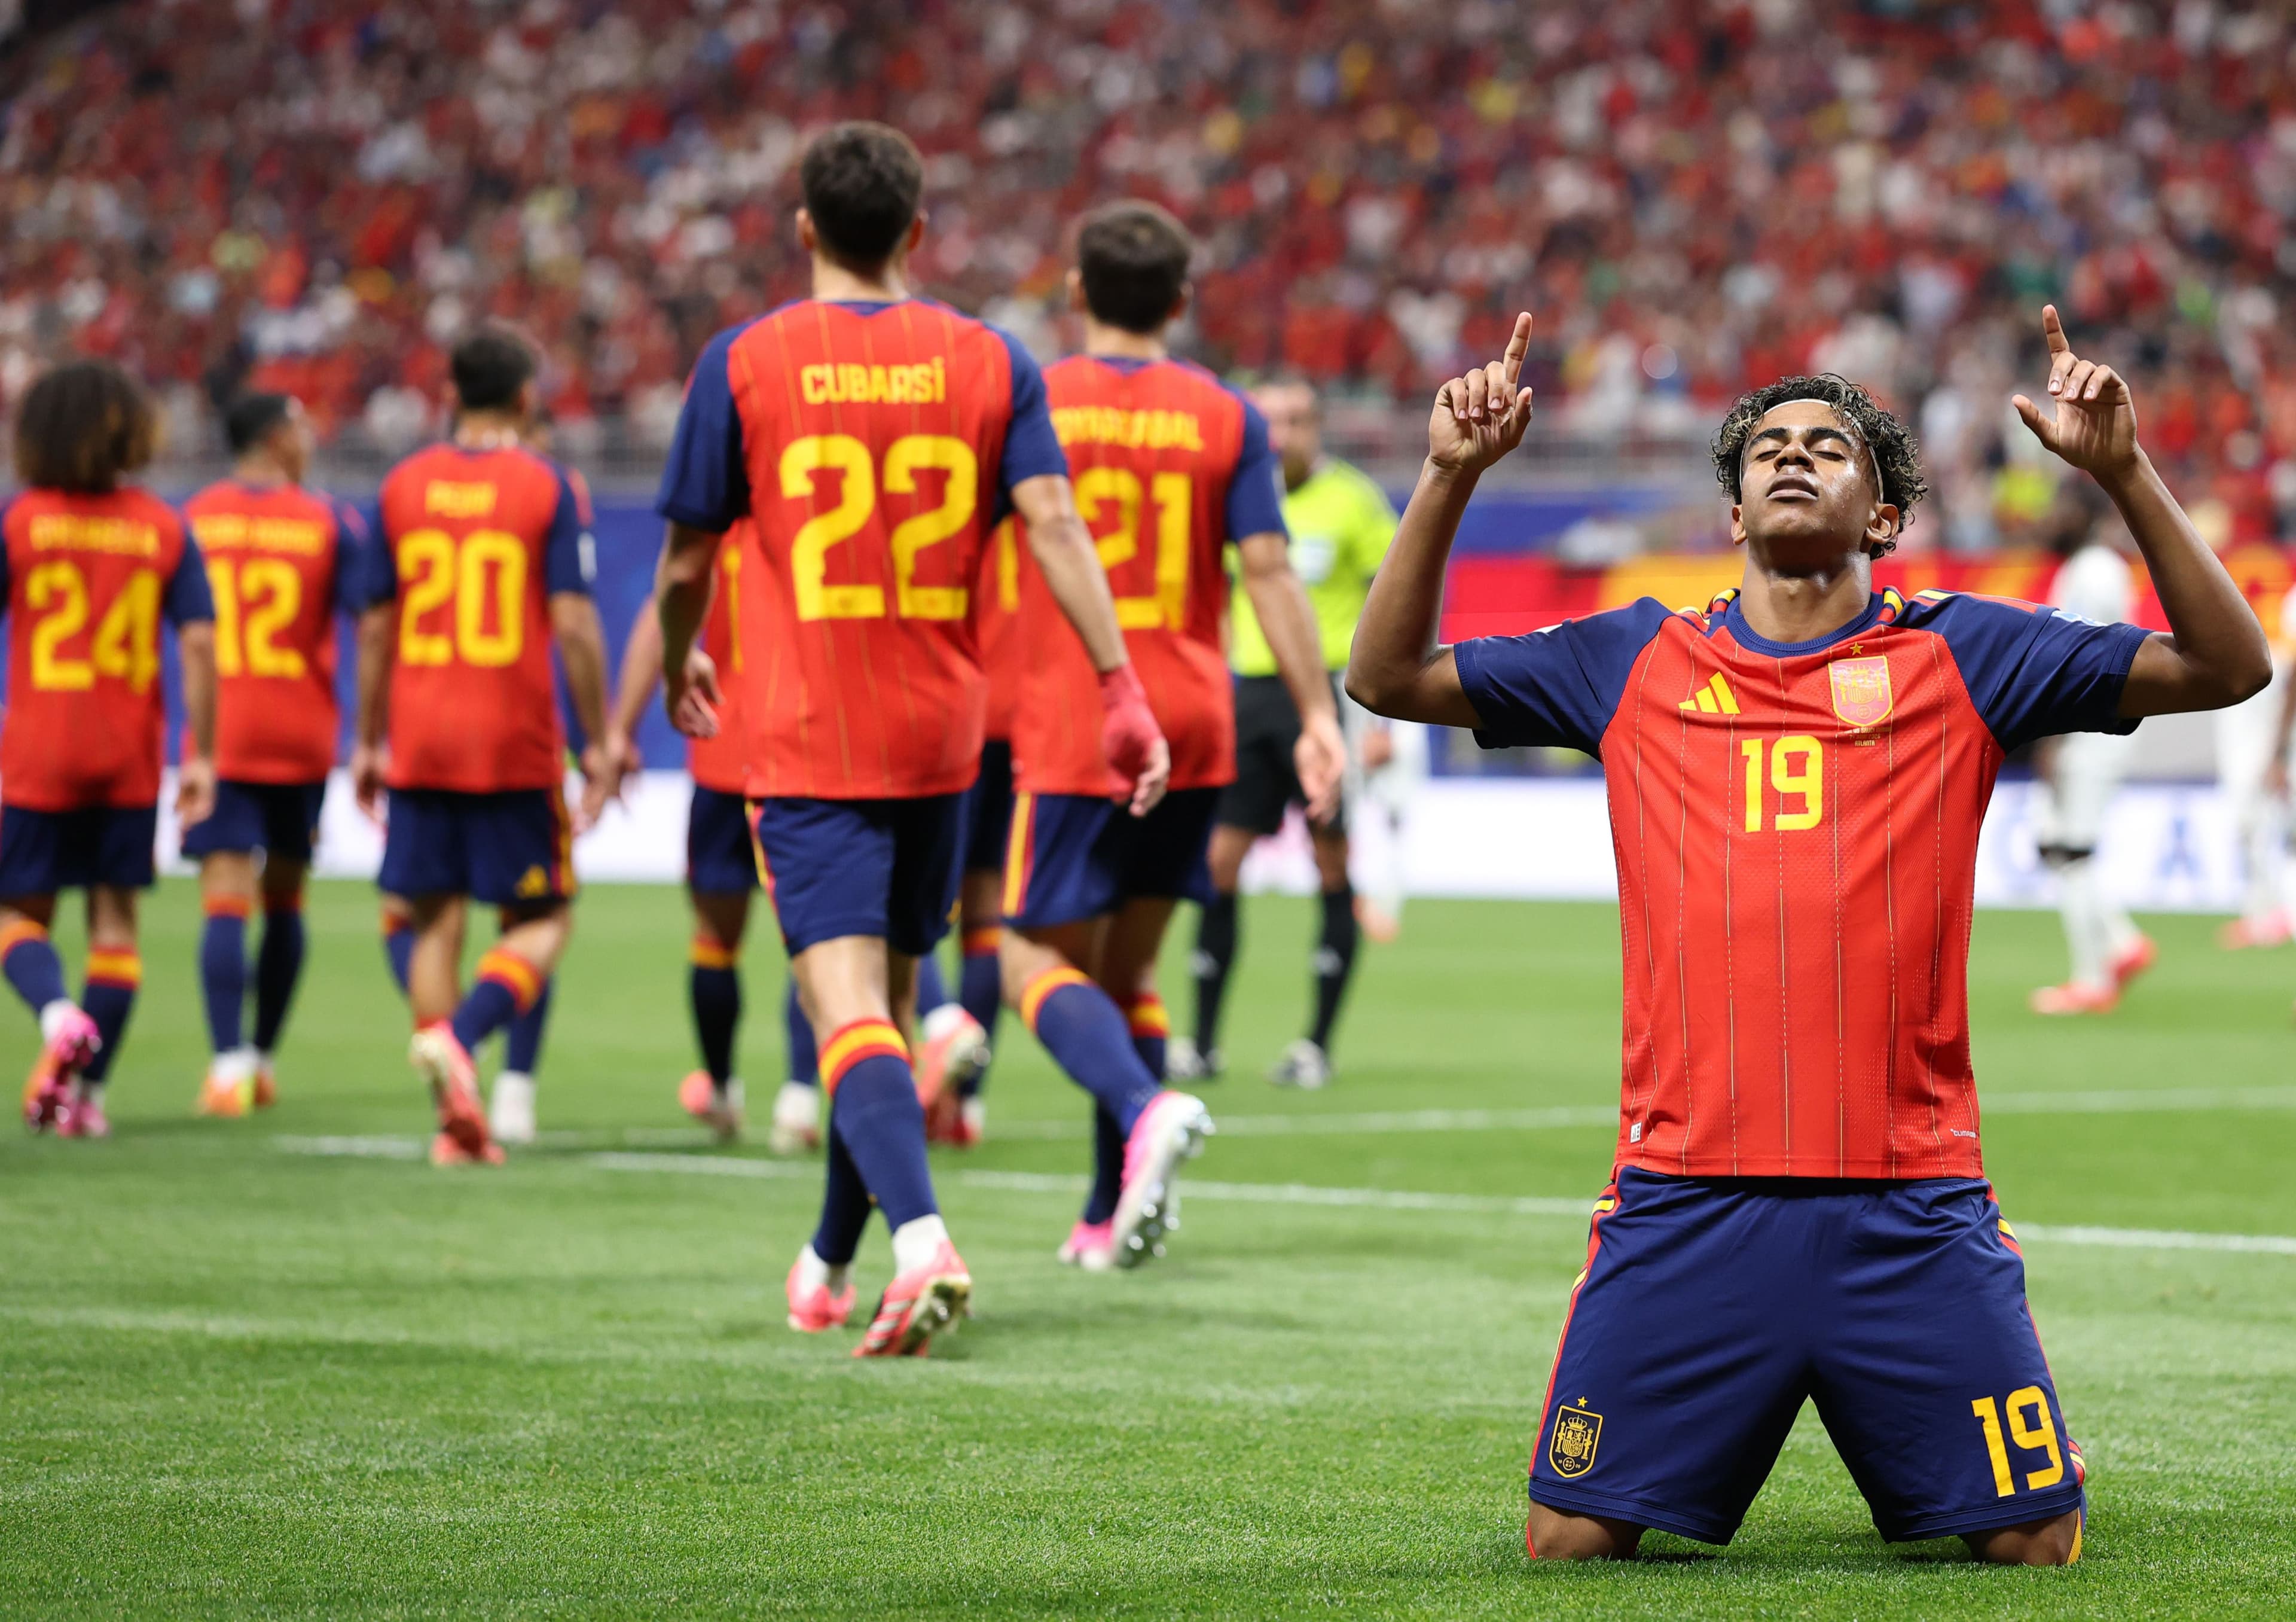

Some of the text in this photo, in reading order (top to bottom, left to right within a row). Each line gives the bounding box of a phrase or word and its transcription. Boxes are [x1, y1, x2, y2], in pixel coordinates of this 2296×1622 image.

[799, 355, 947, 405] CUBARSÍ
[779, 434, 978, 622] 22
[1070, 465, 1192, 632] 21
[25, 560, 160, 693] 24
[206, 555, 306, 679] 12
[396, 528, 527, 666] 20
[1741, 735, 1824, 833] 19
[1971, 1386, 2064, 1498] 19
